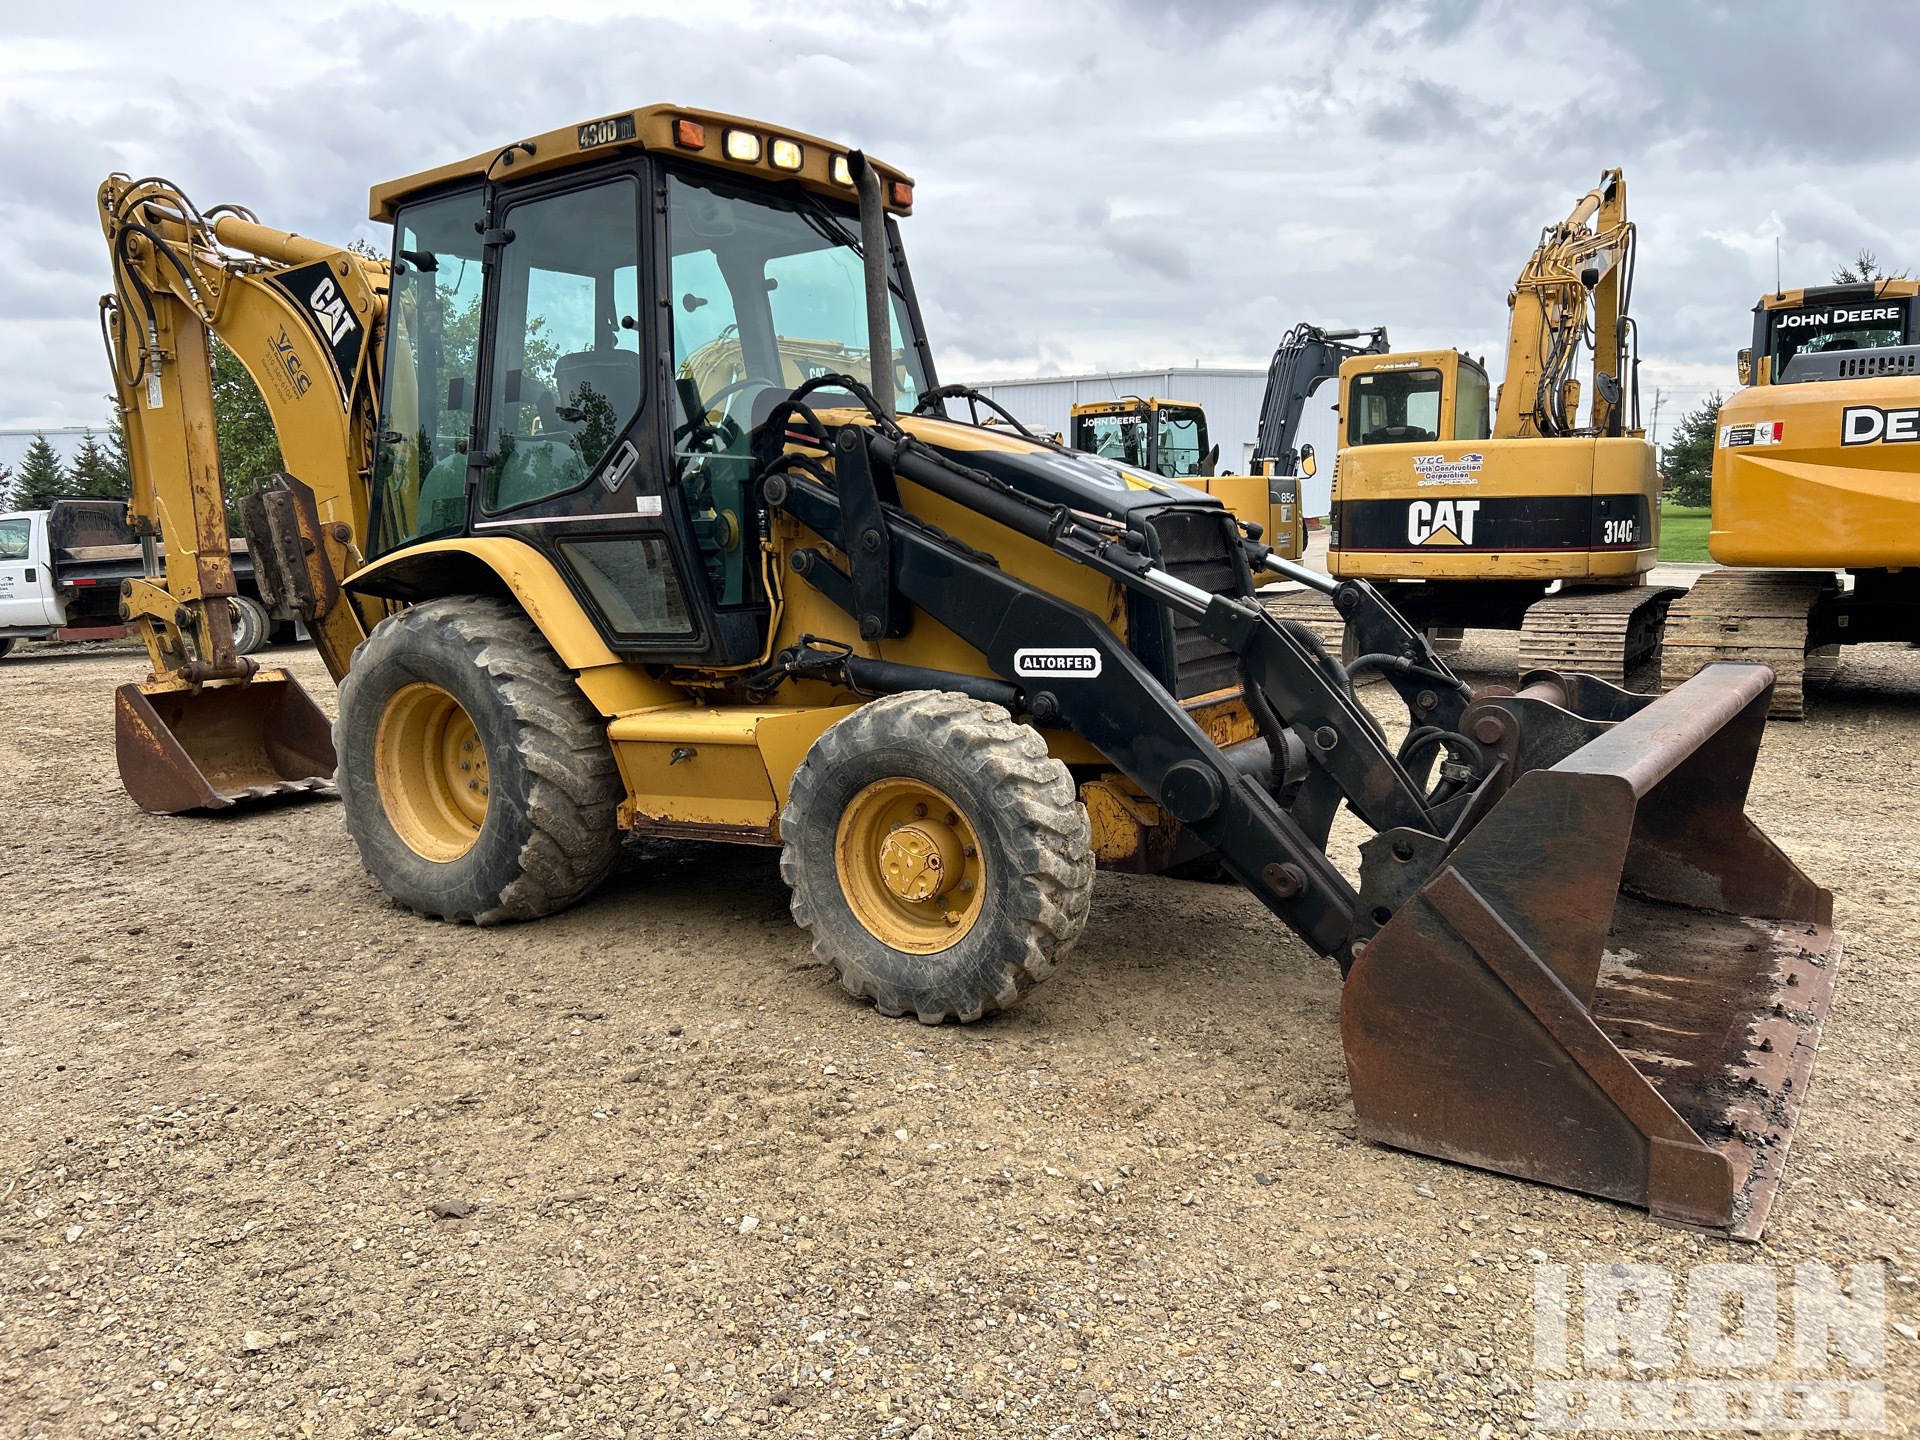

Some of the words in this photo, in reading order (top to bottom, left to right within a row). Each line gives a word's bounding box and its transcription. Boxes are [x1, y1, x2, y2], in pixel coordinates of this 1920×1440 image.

[580, 120, 617, 147] 430D
[310, 277, 357, 347] CAT
[1776, 313, 1829, 329] JOHN
[1833, 307, 1900, 324] DEERE
[809, 367, 826, 380] CAT
[1082, 417, 1109, 428] JOHN
[1109, 416, 1142, 425] DEERE
[1425, 472, 1469, 480] Corporation
[1434, 464, 1481, 472] Construction
[1408, 500, 1480, 546] CAT
[1603, 519, 1633, 544] 314C
[1023, 657, 1092, 669] ALTORFER
